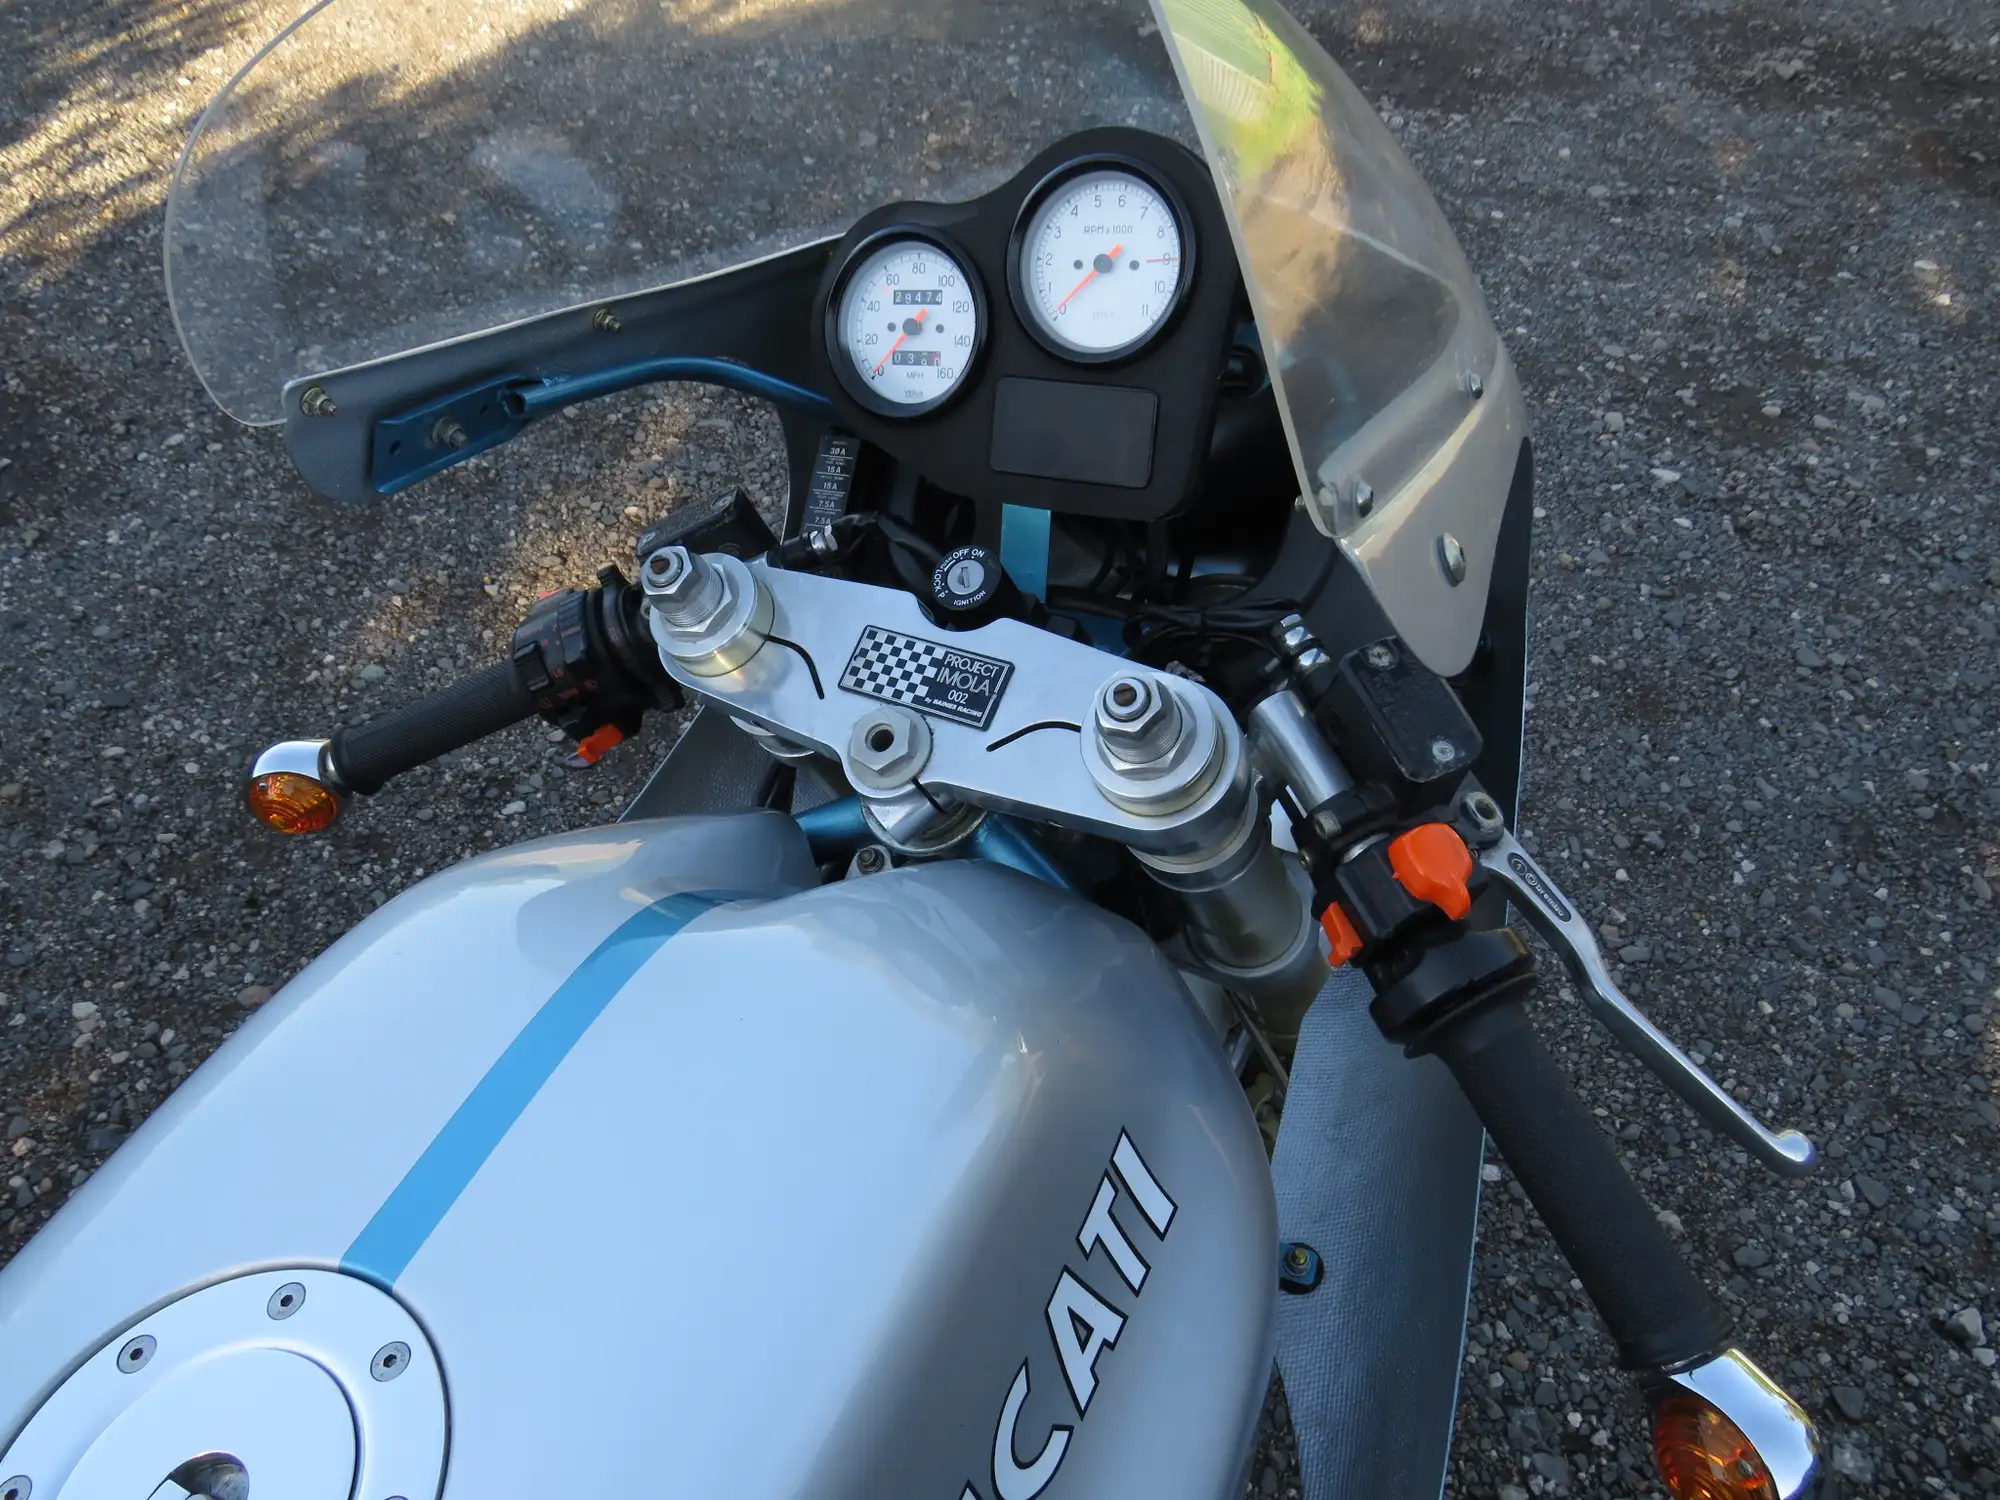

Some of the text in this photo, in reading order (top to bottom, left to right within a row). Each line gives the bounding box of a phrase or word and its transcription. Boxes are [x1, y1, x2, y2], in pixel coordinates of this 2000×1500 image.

[1094, 195, 1102, 208] 5
[1118, 195, 1126, 208] 6
[1070, 205, 1079, 217] 4
[1140, 206, 1149, 220] 7
[1054, 227, 1062, 239] 3
[1157, 227, 1165, 239] 8
[1045, 253, 1053, 266] 2
[1162, 253, 1171, 266] 9
[912, 263, 926, 275] 80
[886, 274, 900, 286] 60
[938, 275, 955, 287] 100
[1154, 280, 1166, 294] 10
[867, 301, 881, 312] 40
[952, 301, 970, 313] 120
[1059, 303, 1067, 315] 0
[1141, 304, 1149, 316] 11
[865, 334, 878, 345] 20
[954, 335, 971, 347] 140
[877, 365, 885, 377] 0
[906, 371, 924, 380] MPH
[936, 367, 954, 380] 160
[952, 548, 970, 559] OFF
[971, 548, 985, 558] ON
[940, 556, 953, 570] PUSH
[933, 569, 944, 593] LOCK
[953, 590, 987, 606] IGNITION
[945, 654, 999, 677] PROJECT
[937, 667, 990, 696] IMOLA
[947, 689, 969, 705] 002
[956, 705, 983, 718] RACING
[1535, 884, 1564, 917] brembo
[957, 1125, 1179, 1500] CATI
